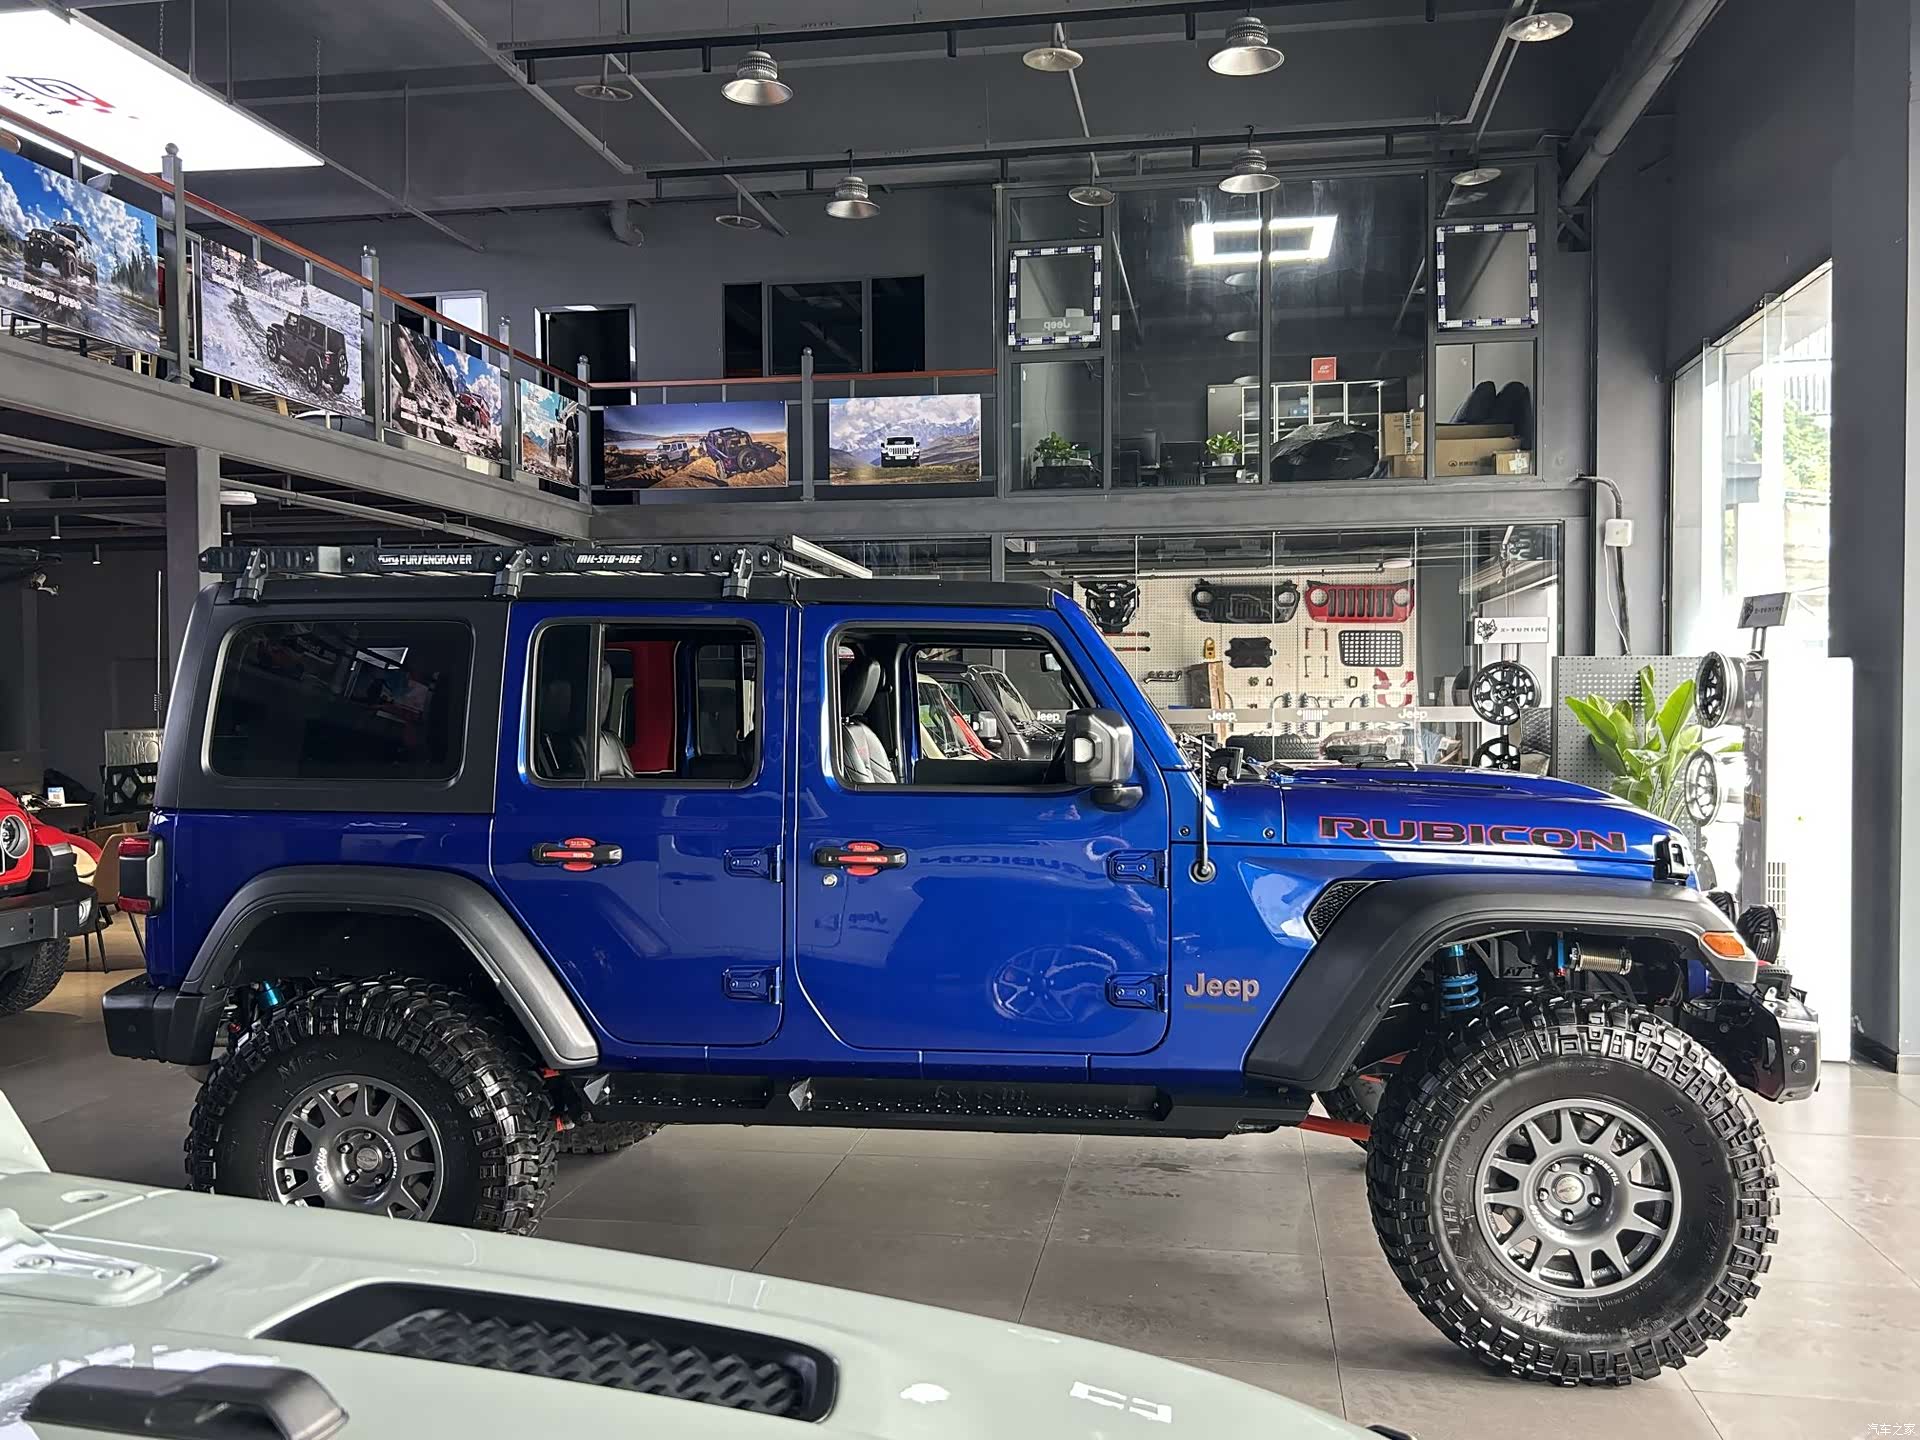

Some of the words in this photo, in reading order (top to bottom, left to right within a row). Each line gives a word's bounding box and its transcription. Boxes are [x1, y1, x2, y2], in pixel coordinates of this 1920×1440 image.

[399, 554, 472, 565] FURYENGRAVER
[1036, 710, 1061, 723] Jeep
[1207, 709, 1237, 722] Jeep
[1397, 708, 1428, 720] Jeep
[1318, 815, 1627, 853] RUBICON
[1184, 971, 1261, 1002] Jeep
[1582, 1152, 1621, 1187] FONDMETAL
